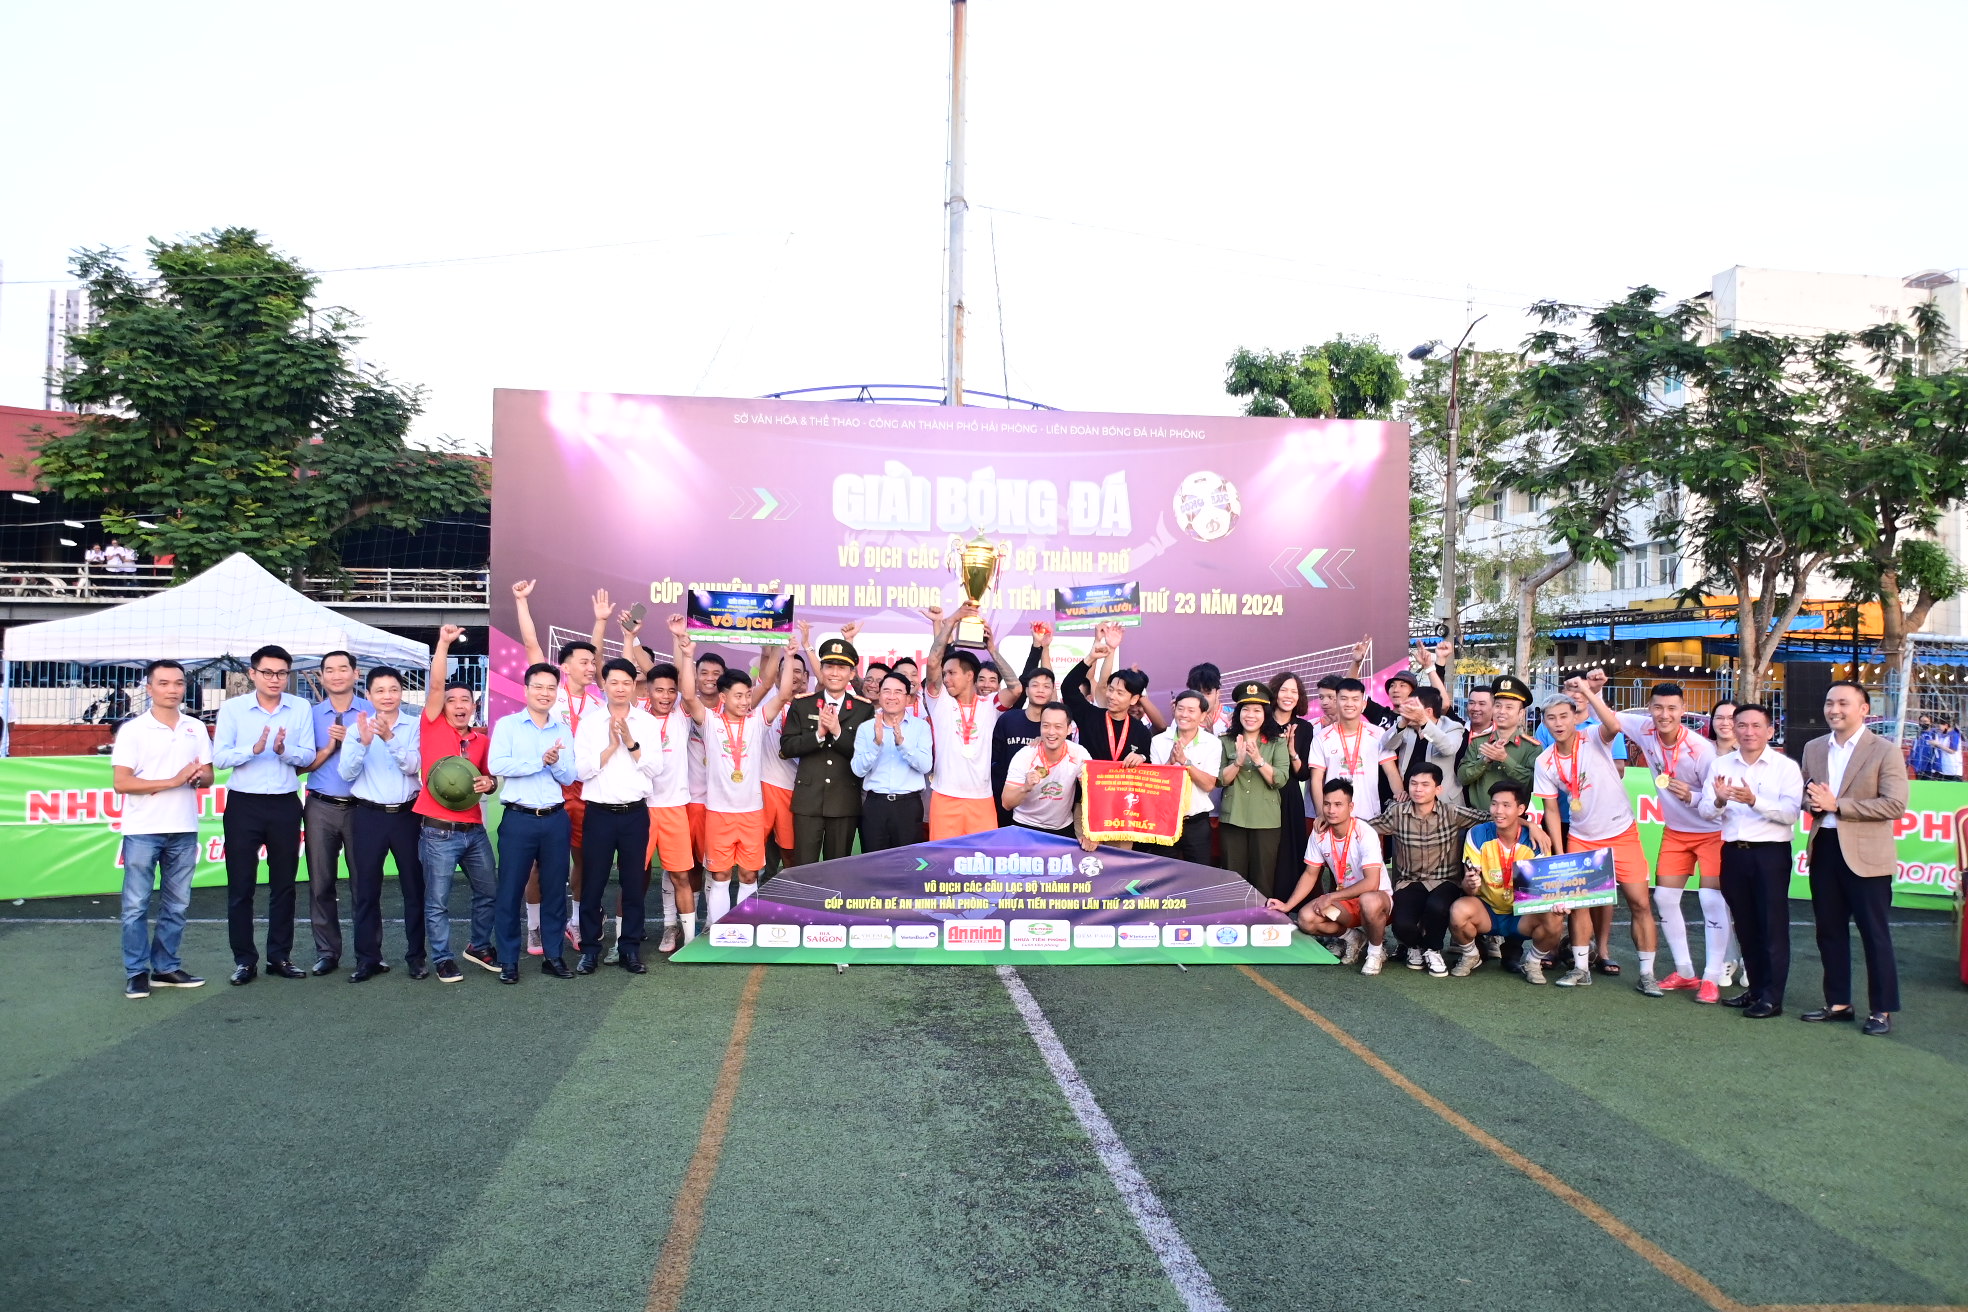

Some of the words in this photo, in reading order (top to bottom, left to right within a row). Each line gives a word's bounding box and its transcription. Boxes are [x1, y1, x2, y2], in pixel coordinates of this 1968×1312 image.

[751, 413, 773, 425] VĂN
[775, 414, 799, 426] HÓA
[800, 416, 808, 426] &
[832, 417, 861, 428] THAO
[868, 417, 899, 429] CÔNG
[901, 419, 916, 430] AN
[918, 418, 954, 431] THÀNH
[1001, 422, 1038, 434] PHÒNG
[1046, 422, 1068, 435] LIÊN
[1070, 423, 1100, 436] ĐOÀN
[1102, 424, 1131, 437] BÓNG
[937, 466, 1058, 534] BÓNG
[1067, 470, 1132, 536] ĐÁ
[838, 540, 860, 568] VÔ
[864, 545, 903, 573] ĐỊCH
[908, 542, 940, 570] CÁC
[1015, 546, 1037, 575] BỘ
[1041, 544, 1093, 574] THÀNH
[1098, 546, 1134, 575] PHỐ
[650, 577, 684, 605] CÚP
[811, 584, 851, 607] NINH
[855, 579, 883, 608] HẢI
[886, 580, 941, 609] PHÒNG
[1140, 587, 1170, 614] THỨ
[1174, 592, 1196, 614] 23
[1200, 589, 1237, 615] NĂM
[1241, 594, 1284, 616] 2024
[1066, 607, 1086, 616] VUA
[736, 616, 774, 631] ĐỊCH
[1104, 818, 1125, 828] ĐỘI
[1128, 820, 1157, 830] NHẤT
[953, 851, 993, 875] GIẢI
[996, 852, 1044, 875] BÓNG
[1047, 853, 1074, 876] ĐÁ
[924, 880, 937, 893] VÔ
[939, 881, 962, 895] ĐỊCH
[963, 880, 983, 893] CÁC
[984, 880, 1003, 893] CÂU
[1005, 881, 1024, 895] LẠC
[1025, 880, 1038, 895] BỘ
[1040, 880, 1070, 893] THÀNH
[1072, 880, 1093, 893] PHỐ
[824, 896, 844, 910] CÚP
[846, 896, 882, 910] CHUYÊN
[899, 898, 913, 910] AN
[914, 898, 937, 910] NINH
[939, 895, 957, 910] HẢI
[958, 896, 989, 910] PHÒNG
[998, 898, 1025, 913] NHỰA
[1048, 898, 1080, 910] PHONG
[1102, 897, 1121, 910] THỨ
[1122, 899, 1135, 910] 23
[1137, 897, 1160, 910] NĂM
[1161, 898, 1187, 910] 2024
[948, 926, 968, 940] An
[970, 926, 1002, 940] ninh
